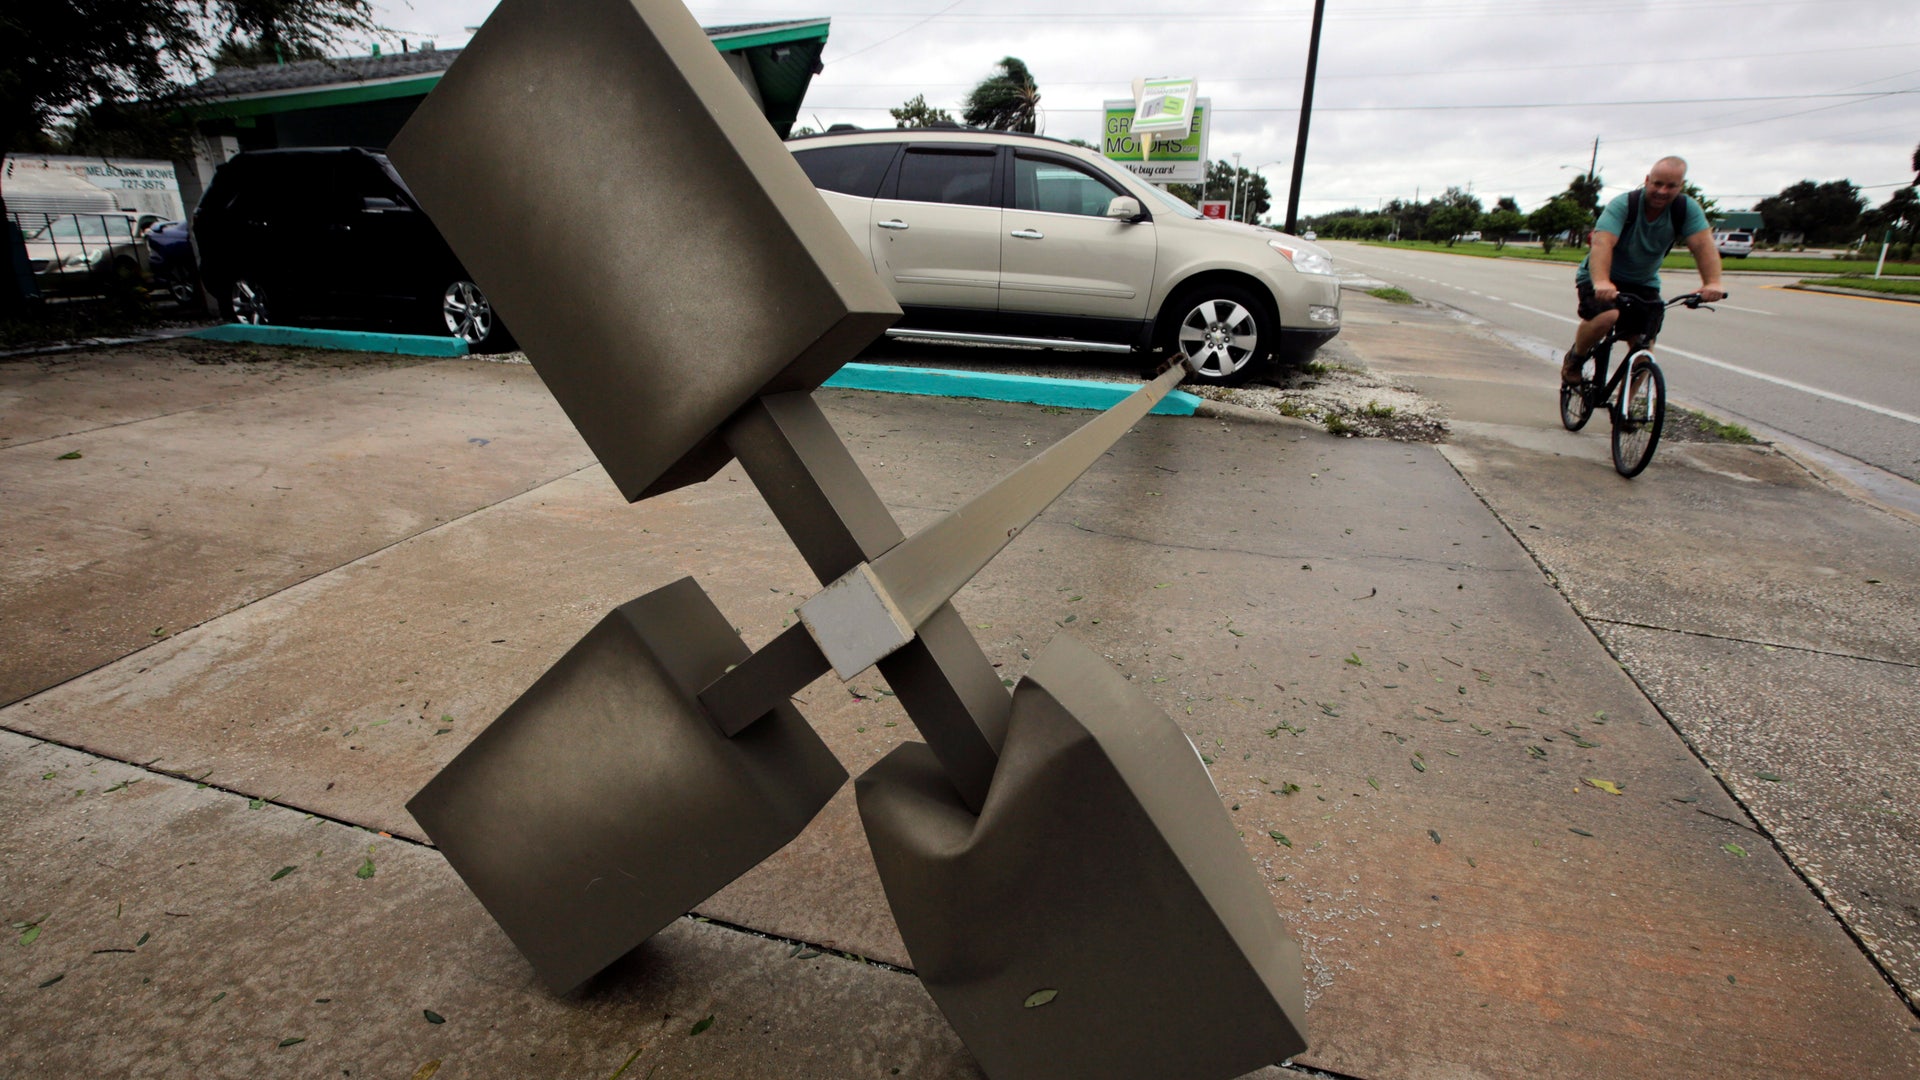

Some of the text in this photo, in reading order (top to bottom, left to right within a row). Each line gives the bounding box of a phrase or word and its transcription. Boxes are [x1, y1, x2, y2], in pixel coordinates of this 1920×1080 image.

[85, 166, 144, 178] MELBOURNE
[1139, 165, 1155, 176] buy
[1155, 164, 1176, 174] cars!
[120, 178, 166, 189] 727-3575
